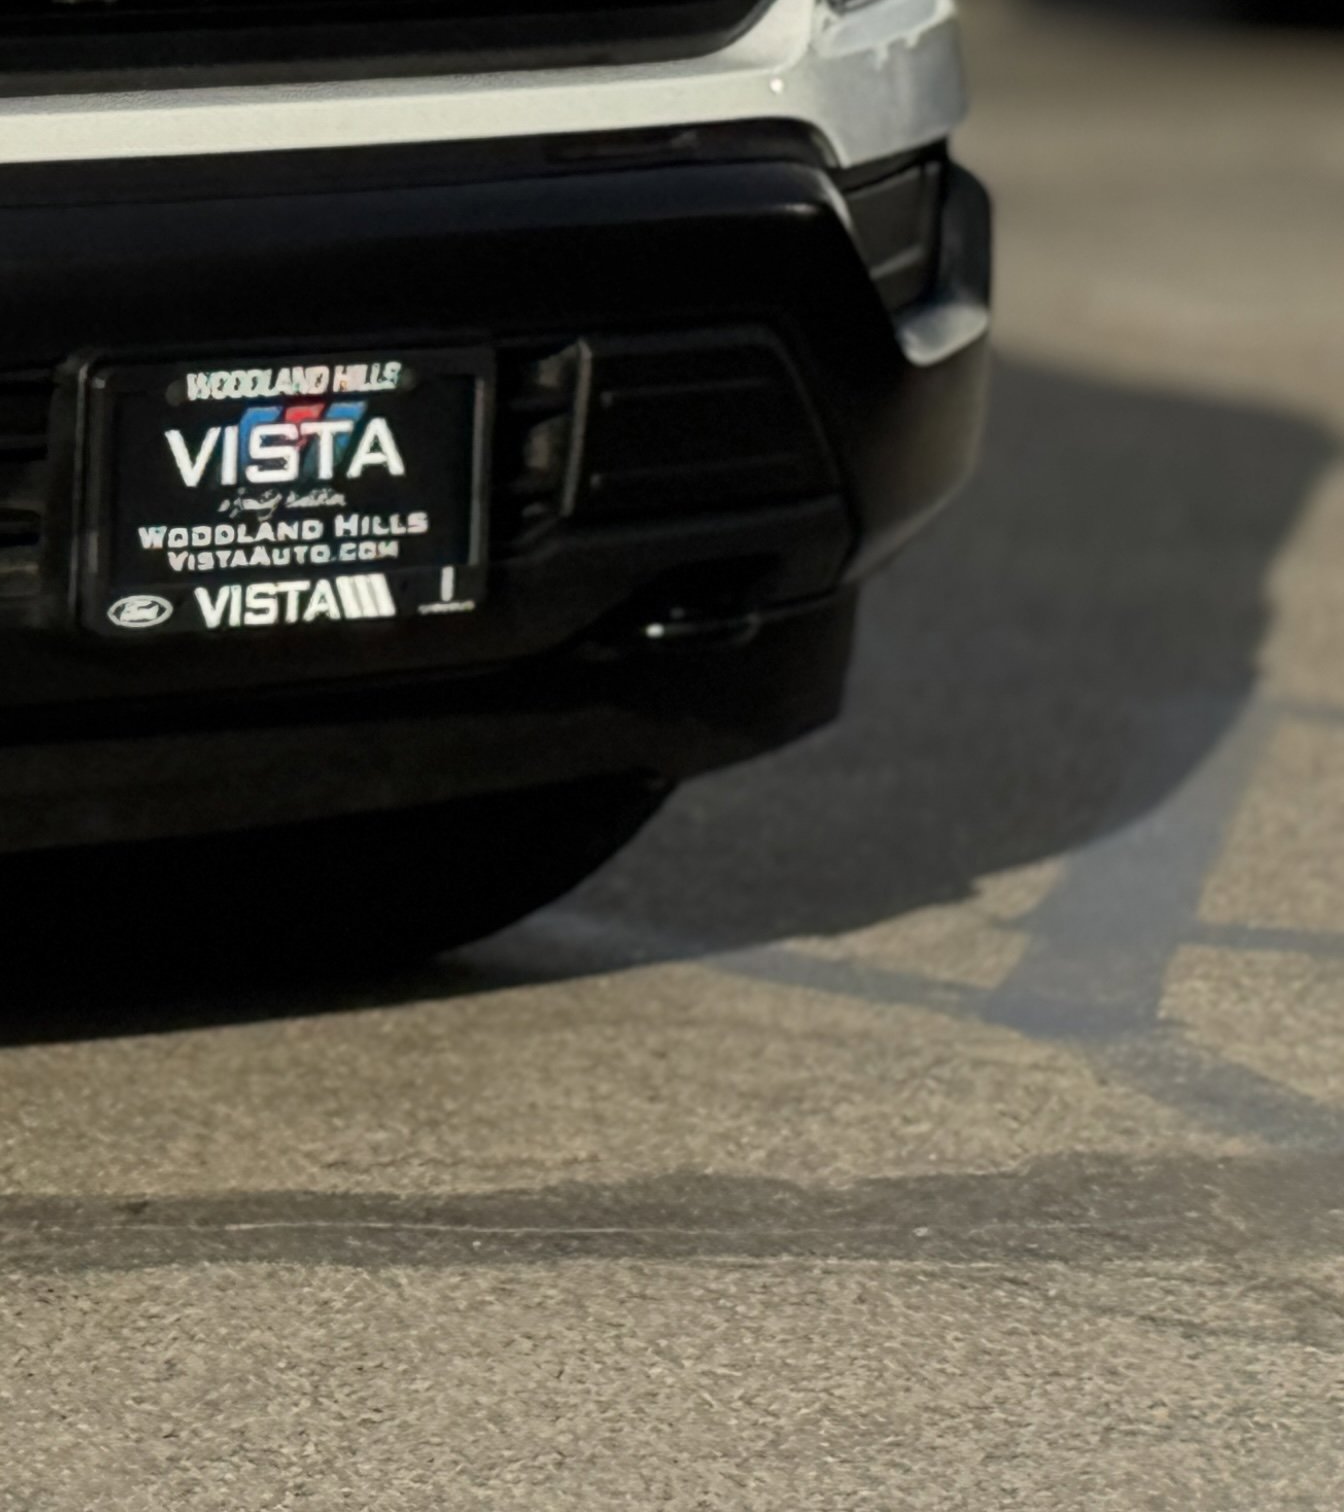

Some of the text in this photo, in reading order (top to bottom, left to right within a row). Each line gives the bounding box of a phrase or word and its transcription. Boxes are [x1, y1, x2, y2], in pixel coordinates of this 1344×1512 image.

[187, 361, 402, 400] WOODLAND HILLS
[165, 418, 405, 487] VISTA
[139, 510, 430, 549] WOODLAND HILLS
[194, 581, 341, 628] VISTA
